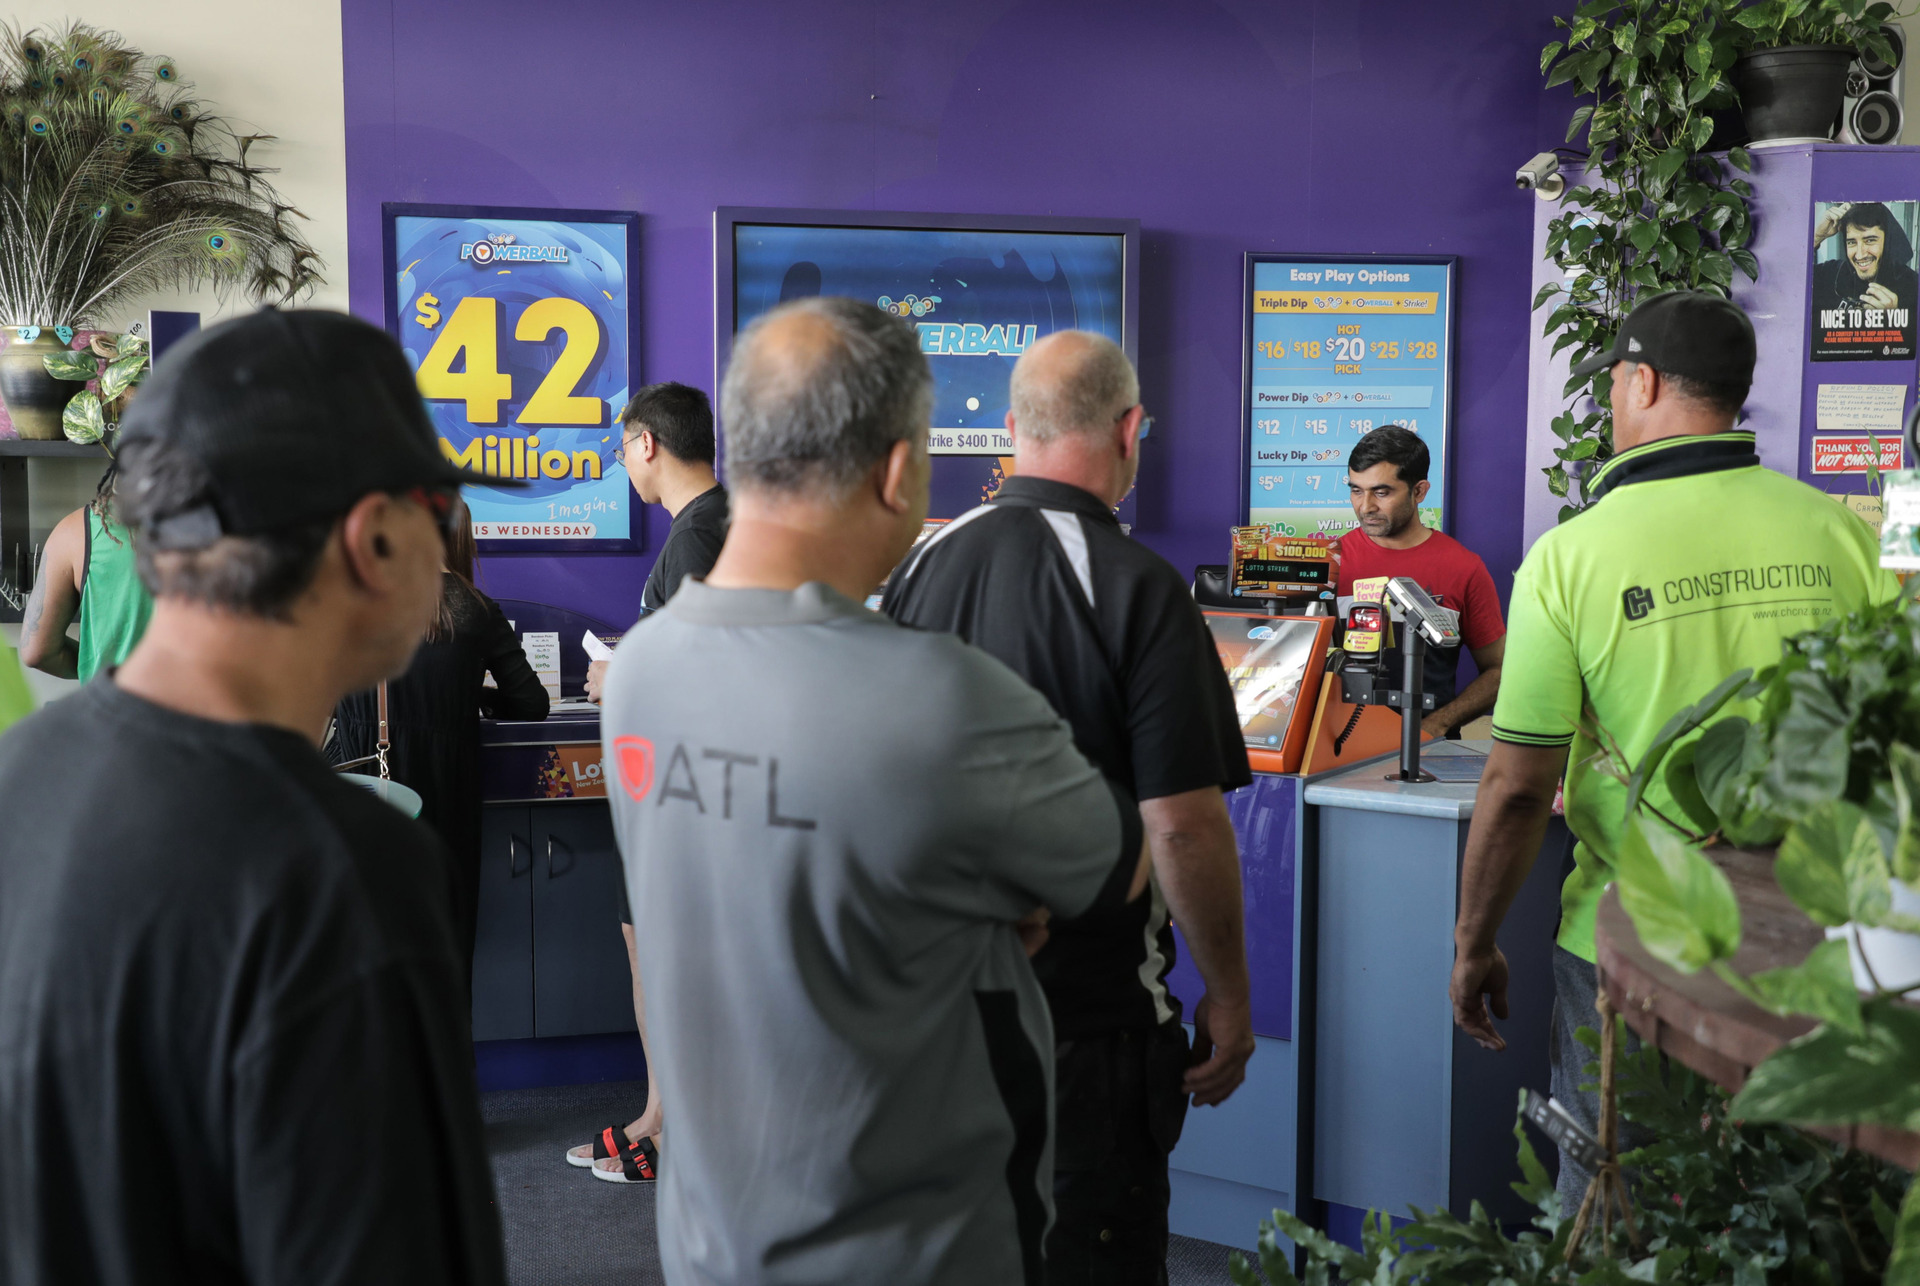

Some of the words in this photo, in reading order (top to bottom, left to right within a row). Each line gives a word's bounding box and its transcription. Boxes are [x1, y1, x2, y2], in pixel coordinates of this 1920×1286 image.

[461, 240, 568, 264] POWERBALL
[1290, 269, 1322, 284] Easy
[1325, 269, 1354, 284] Play
[1358, 269, 1410, 284] Options
[1260, 298, 1289, 309] Triple
[1291, 298, 1308, 309] Dip
[1352, 298, 1394, 308] POWERBALL
[1403, 299, 1428, 308] Strike!
[1820, 309, 1845, 328] NICE
[1848, 309, 1862, 328] TO
[1864, 309, 1884, 328] SEE
[1886, 309, 1908, 327] YOU
[1337, 325, 1361, 335] HOT
[913, 323, 1037, 356] ERBALL
[1258, 341, 1285, 359] $16
[1294, 341, 1321, 359] $18
[1325, 337, 1365, 361] $20
[1370, 342, 1399, 359] $25
[1408, 342, 1437, 359] $28
[1334, 364, 1361, 374] PICK
[1258, 393, 1289, 402] Power
[1291, 393, 1308, 404] Dip
[1258, 419, 1280, 435] $12
[1305, 419, 1327, 435] $15
[1350, 419, 1372, 434] $18
[928, 434, 953, 447] trike
[957, 434, 987, 448] $400
[992, 435, 1012, 447] Tho
[1817, 444, 1852, 452] THANK
[1880, 443, 1900, 451] FOR
[1258, 451, 1288, 462] Lucky
[1291, 451, 1308, 462] Dip
[1817, 454, 1842, 467] NOT
[1306, 476, 1321, 490] $7
[547, 497, 618, 521] Imagine
[475, 525, 488, 535] IS
[498, 525, 591, 535] WEDNESDAY
[1317, 519, 1342, 531] Win
[1346, 520, 1360, 529] up
[1276, 545, 1327, 559] $100,000
[1356, 582, 1375, 590] Play
[1664, 564, 1832, 604] CONSTRUCTION
[1357, 591, 1385, 601] fave
[656, 743, 817, 831] ATL
